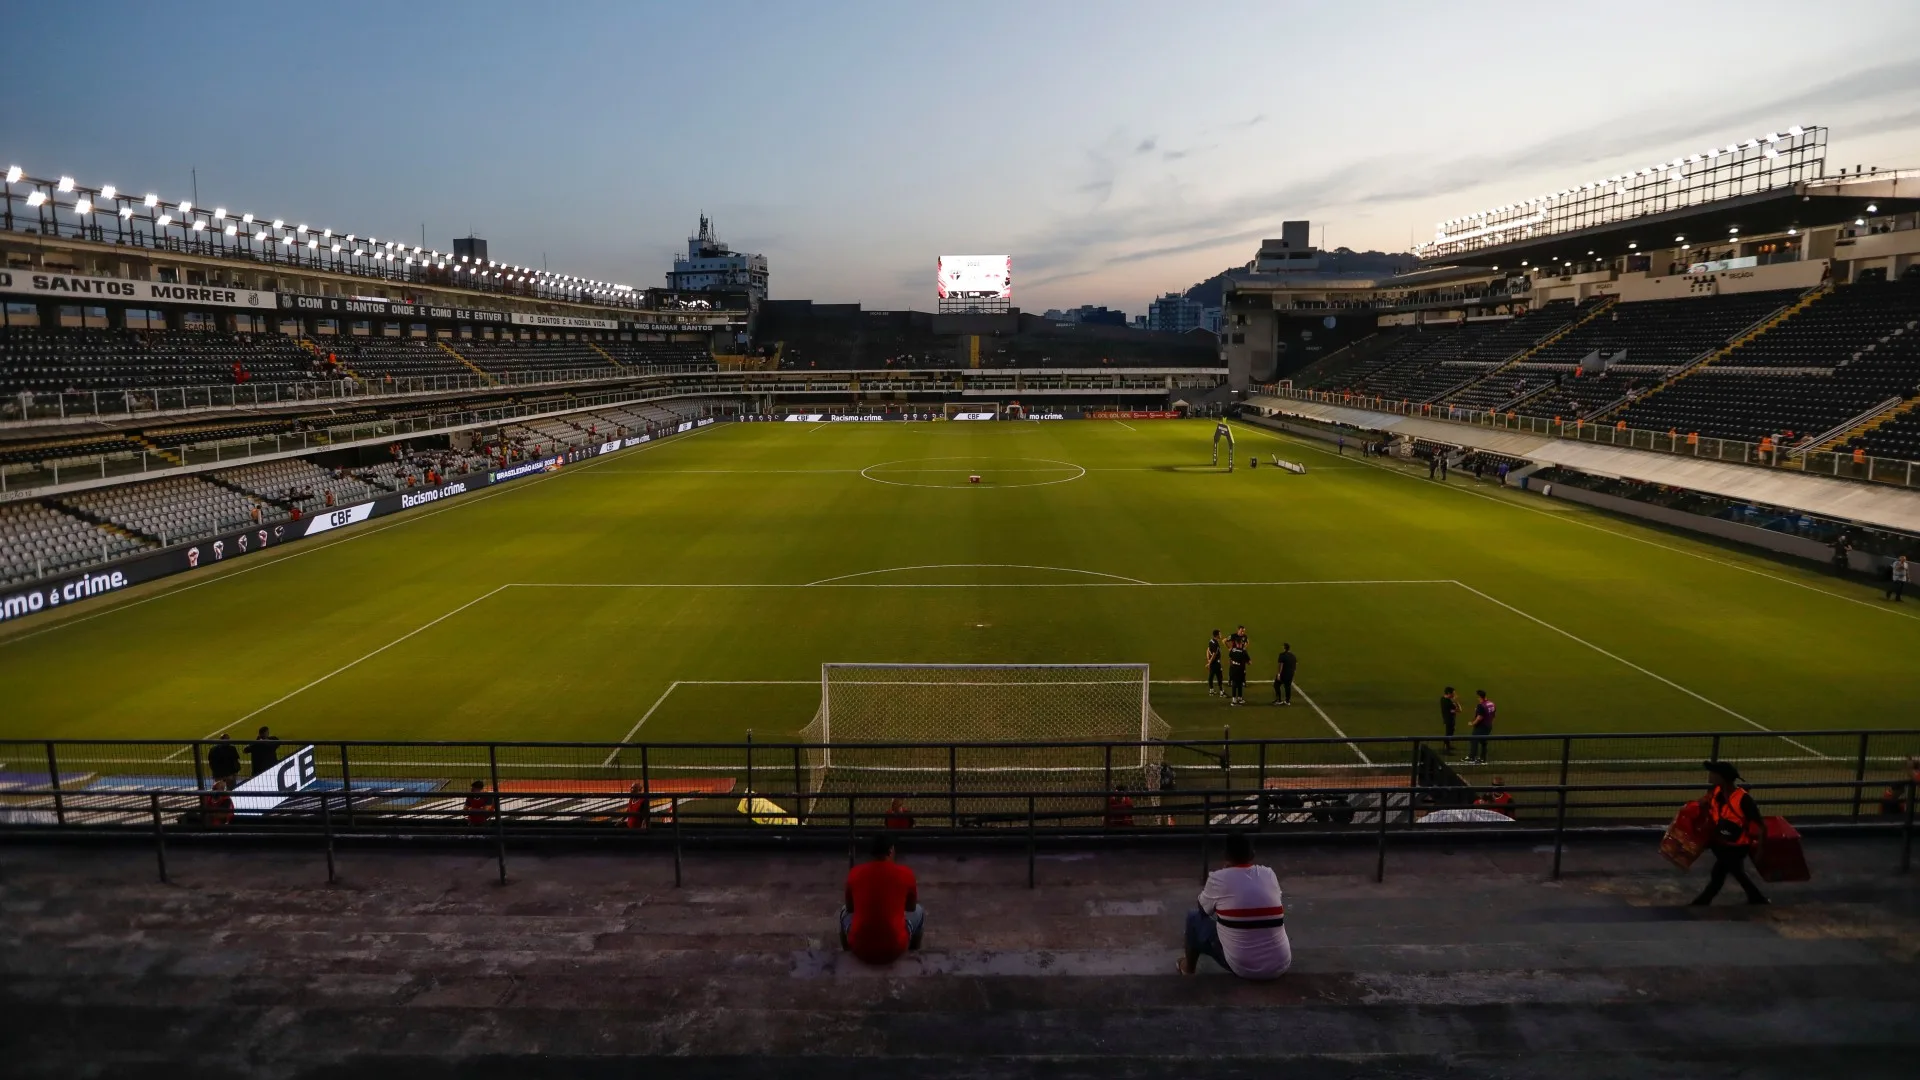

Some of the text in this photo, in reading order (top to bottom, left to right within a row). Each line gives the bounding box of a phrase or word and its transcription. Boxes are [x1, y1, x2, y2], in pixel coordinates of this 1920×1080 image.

[32, 275, 135, 296] SANTOS
[151, 285, 236, 302] MORRER
[298, 297, 323, 309] COM
[331, 299, 338, 310] O
[346, 301, 385, 313] SANTOS
[392, 305, 415, 315] ONDE
[431, 307, 452, 318] COMO
[457, 309, 470, 319] ELE
[474, 311, 502, 321] ESTIVER
[529, 315, 534, 323] O
[537, 316, 560, 324] SANTOS
[574, 319, 591, 327] NOSSA
[1044, 412, 1064, 420] crime.
[496, 464, 532, 480] BRASILEIRÃO
[330, 482, 467, 526] CBF Racismo é crime.
[50, 588, 60, 605] é
[64, 572, 128, 601] crime.
